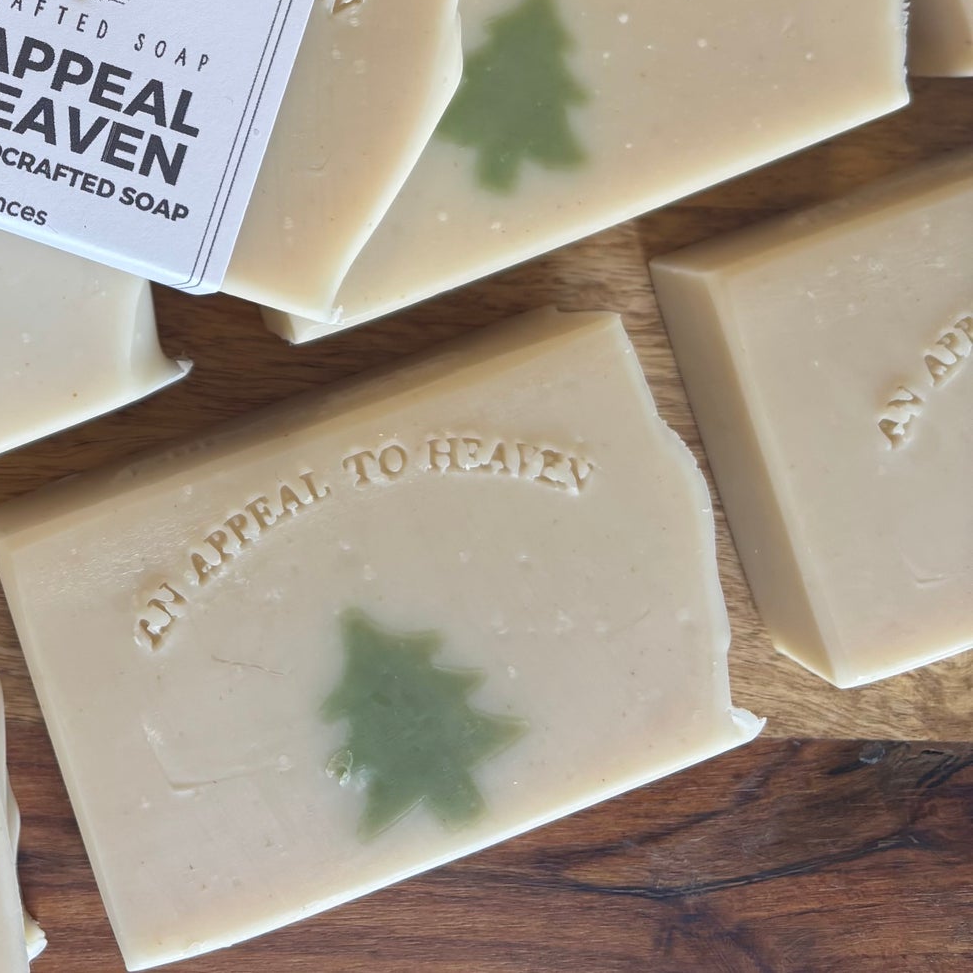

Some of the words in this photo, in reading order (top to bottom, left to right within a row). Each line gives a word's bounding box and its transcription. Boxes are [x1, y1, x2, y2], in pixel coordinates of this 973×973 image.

[134, 32, 210, 70] SOAP
[118, 186, 190, 223] SOAP
[189, 471, 331, 587] APPEAL
[343, 443, 409, 487] TO
